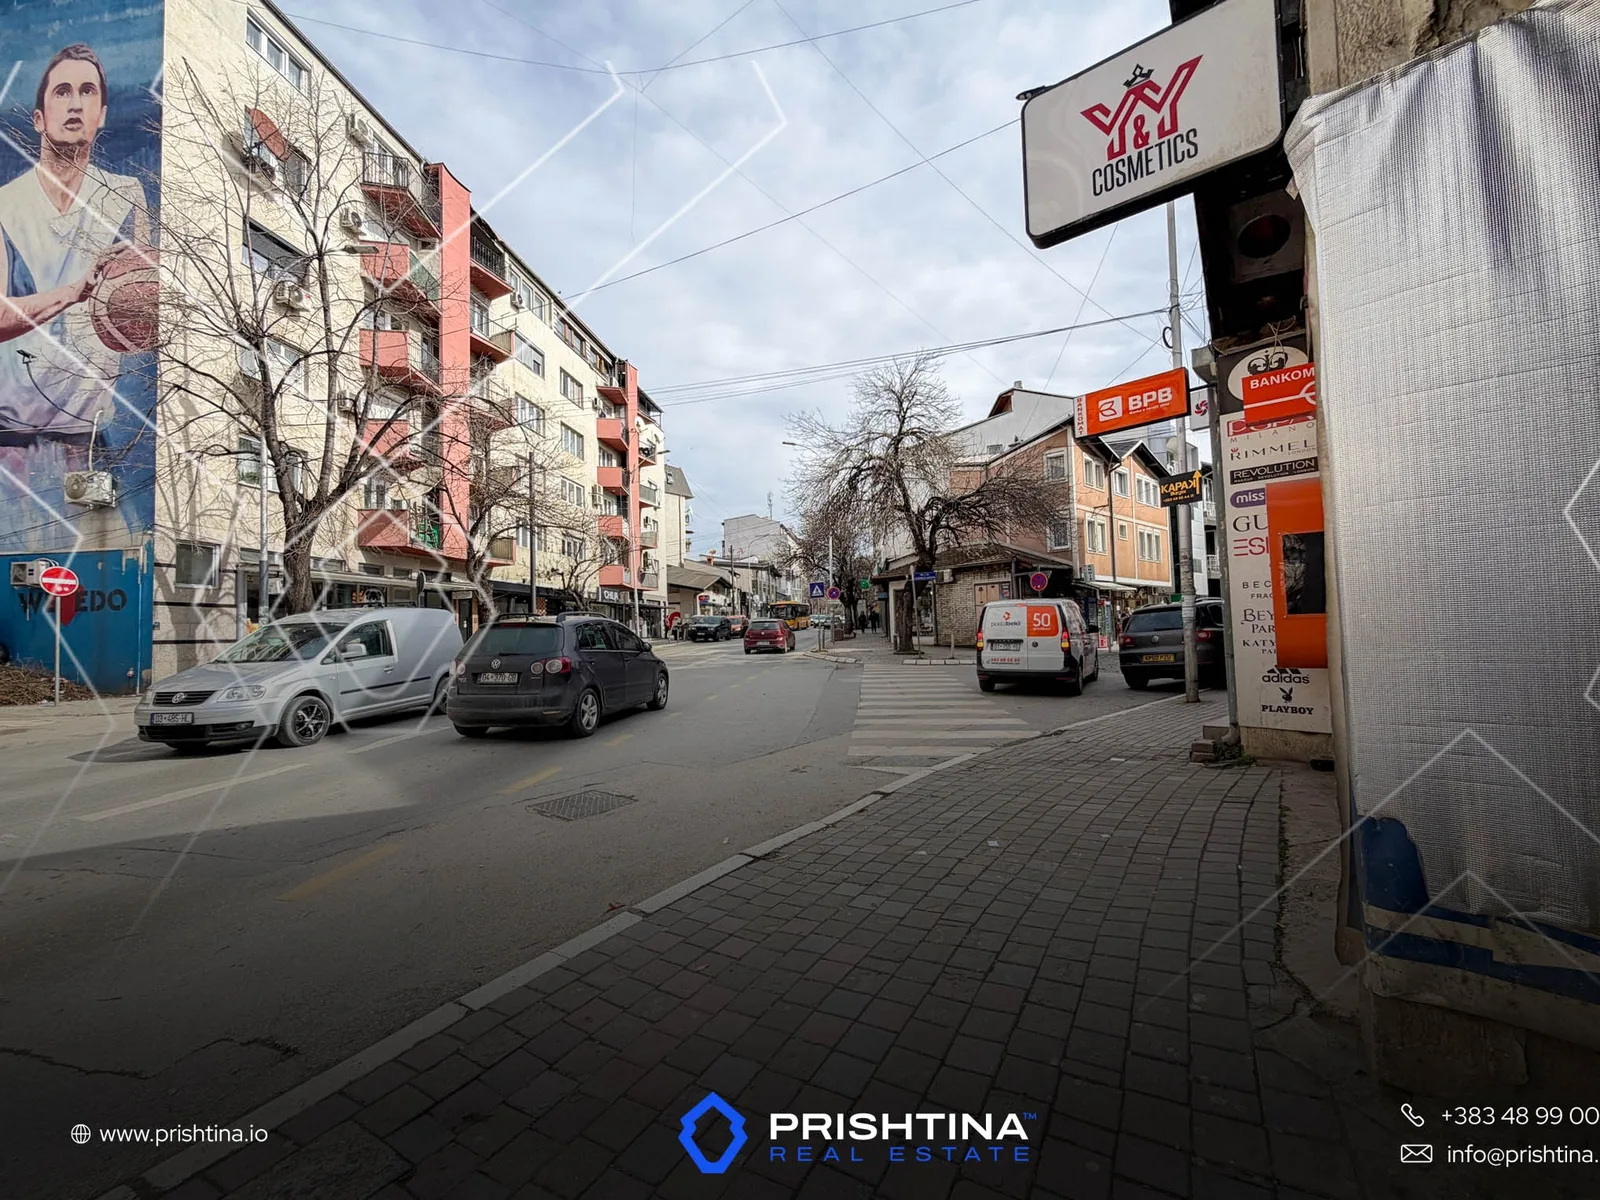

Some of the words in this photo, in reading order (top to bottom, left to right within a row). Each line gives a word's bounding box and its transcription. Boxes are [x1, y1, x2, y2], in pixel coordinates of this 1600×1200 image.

[1092, 128, 1199, 197] COSMETICS
[1250, 367, 1315, 389] BANKOM
[1128, 387, 1173, 410] BPB
[1230, 421, 1315, 444] MILANO
[1231, 439, 1316, 461] RIMMEL
[1233, 459, 1315, 479] REVOLUTION
[1236, 491, 1265, 503] miss
[1233, 514, 1268, 532] GU
[1033, 613, 1051, 627] 50
[1262, 673, 1310, 684] adidas
[1261, 704, 1314, 715] PLAYBOY
